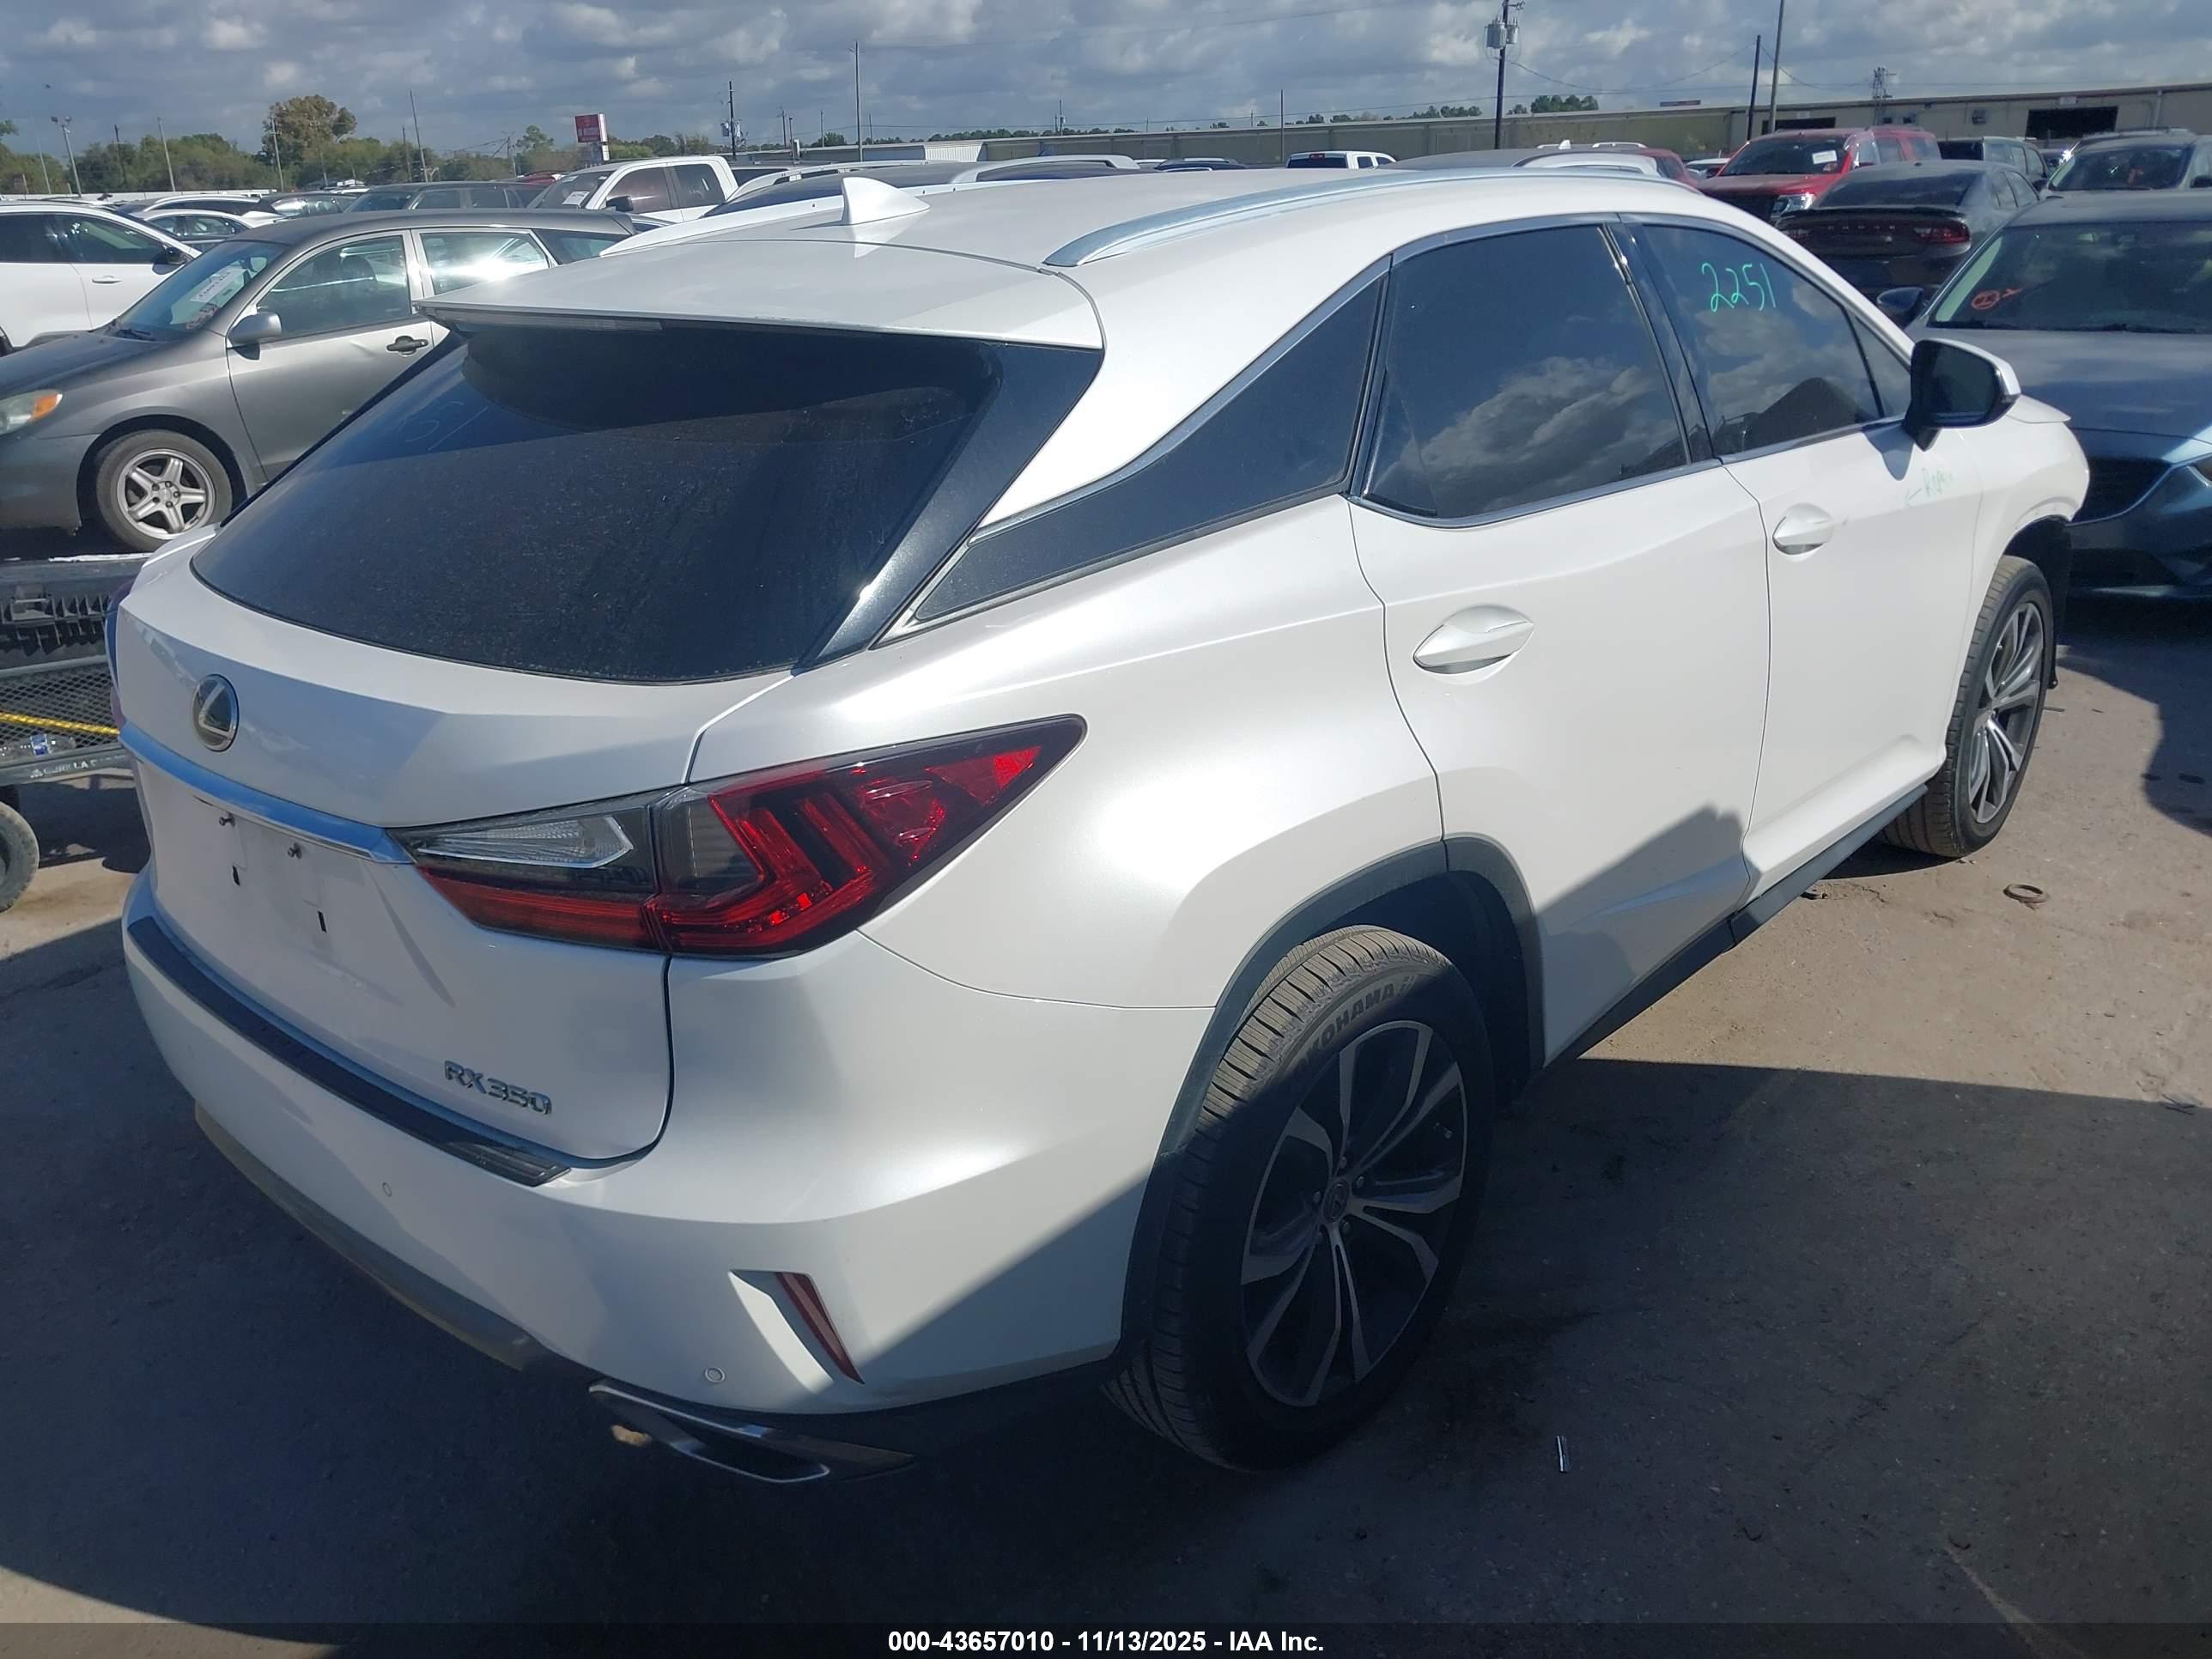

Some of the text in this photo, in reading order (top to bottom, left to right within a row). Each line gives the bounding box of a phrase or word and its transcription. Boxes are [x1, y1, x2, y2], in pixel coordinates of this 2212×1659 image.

[1701, 263, 1776, 313] 2251
[1295, 982, 1395, 1068] KOHAMA
[444, 1060, 552, 1115] RX350
